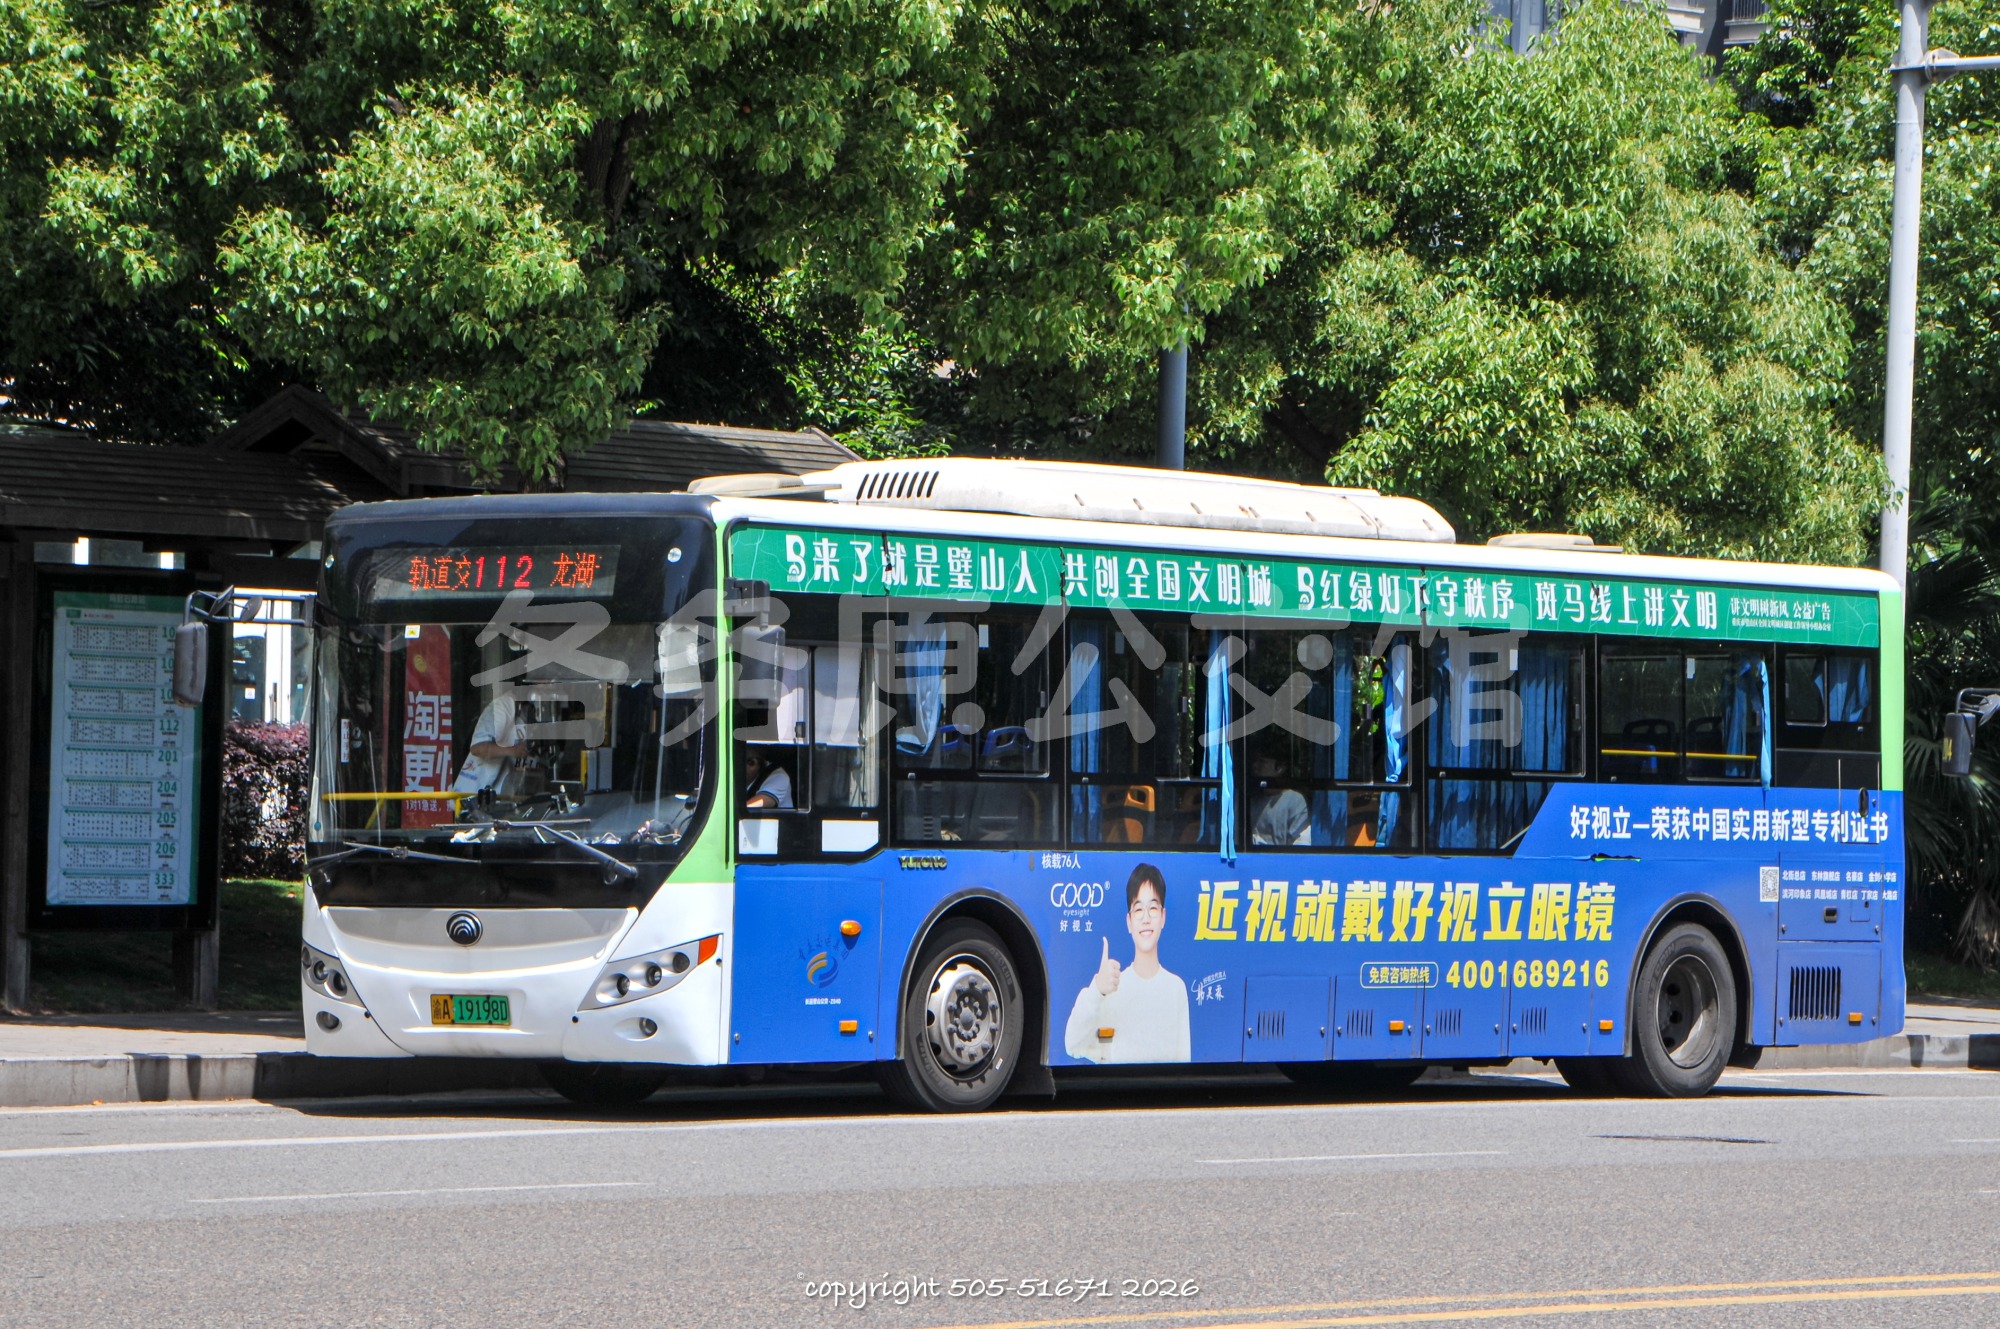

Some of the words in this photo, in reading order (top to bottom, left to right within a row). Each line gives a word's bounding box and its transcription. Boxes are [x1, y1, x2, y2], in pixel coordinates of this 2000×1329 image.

[475, 555, 533, 588] 112
[550, 552, 602, 588] 龙湖
[1064, 553, 1272, 607] 共创全国文明城
[1535, 581, 1718, 630] 斑马线上讲文明
[1793, 601, 1831, 621] 公益广告
[162, 627, 175, 638] 10
[161, 658, 173, 669] 10
[160, 688, 173, 700] 10
[159, 719, 179, 731] 112
[158, 751, 178, 762] 201
[157, 781, 177, 793] 204
[156, 812, 177, 824] 205
[155, 842, 176, 855] 206
[1041, 853, 1081, 870] 核载76人
[154, 873, 175, 885] 333
[1063, 908, 1090, 917] eyesight
[1193, 879, 1616, 943] 近视就戴好视立眼镜
[1059, 919, 1093, 932] 好视立
[1369, 966, 1430, 984] 免费咨询热线
[1446, 959, 1609, 989] 4001689216
